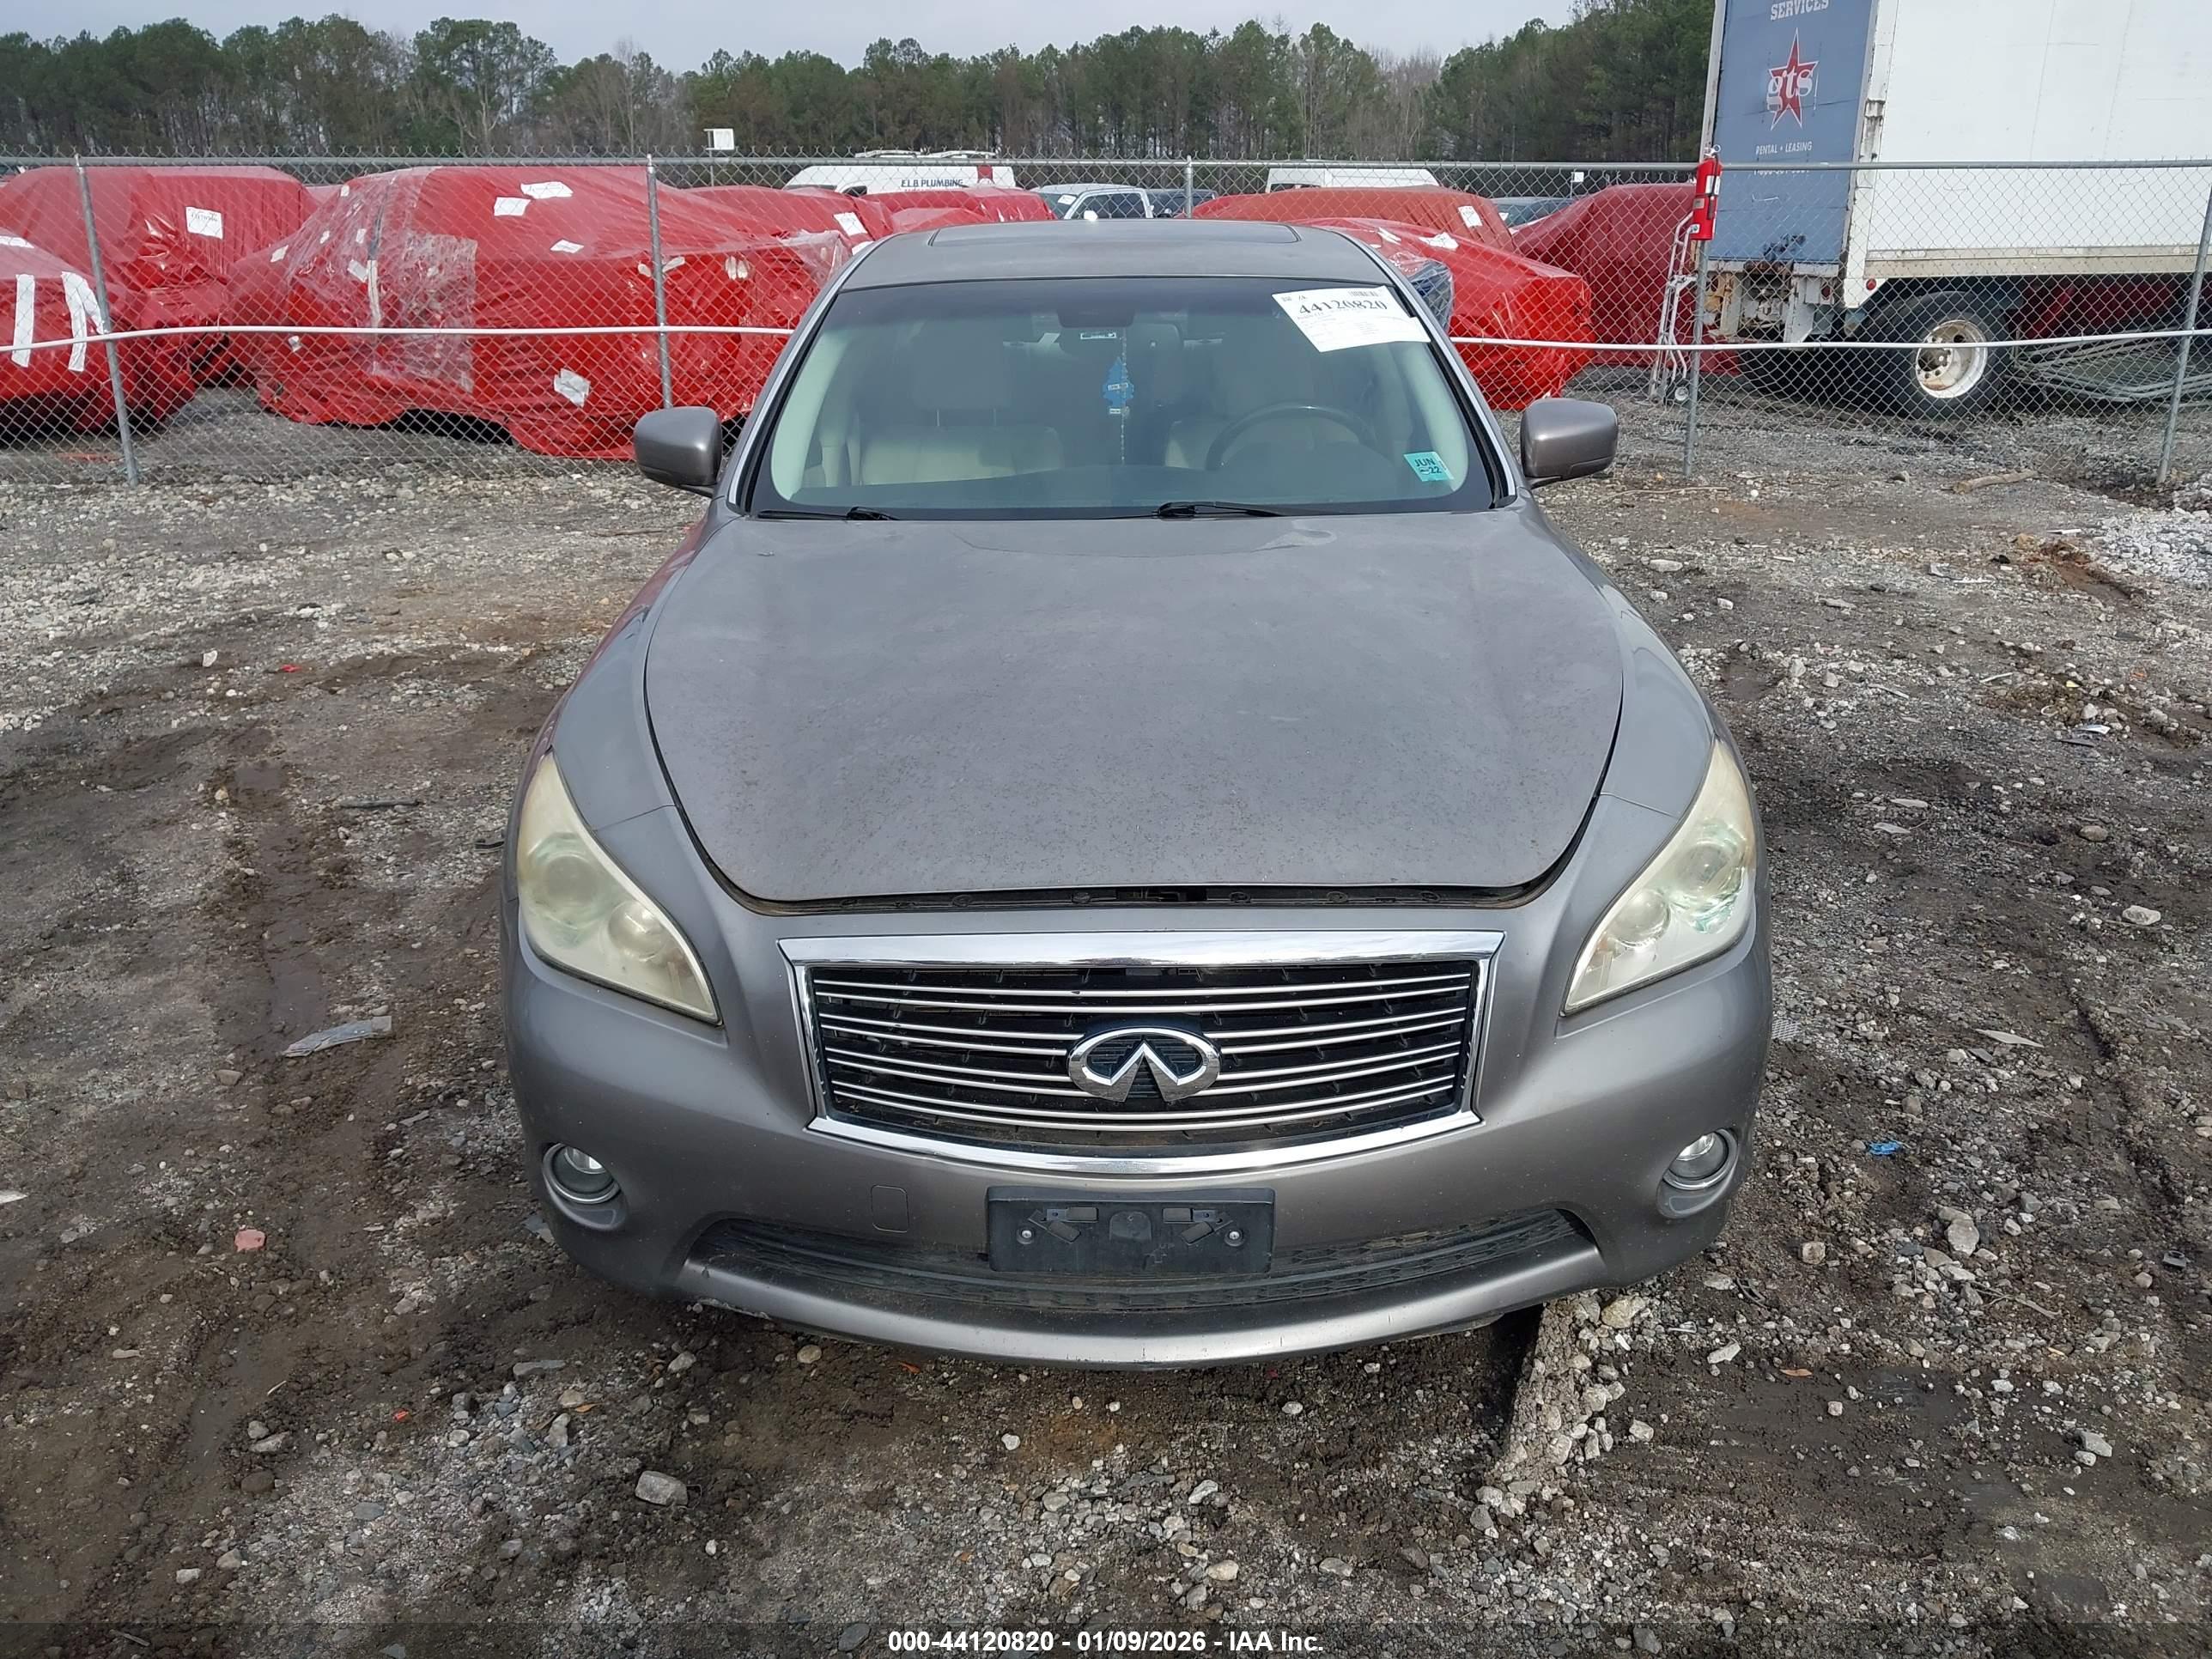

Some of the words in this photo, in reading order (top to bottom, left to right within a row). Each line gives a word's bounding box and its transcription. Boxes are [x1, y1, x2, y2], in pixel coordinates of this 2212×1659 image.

[1771, 0, 1829, 21] SERVICES
[1755, 143, 1778, 155] RENTAL
[1785, 141, 1813, 153] LEASING
[921, 178, 963, 188] PLUMBING
[1299, 299, 1388, 314] 44120820
[1414, 458, 1437, 467] JUN
